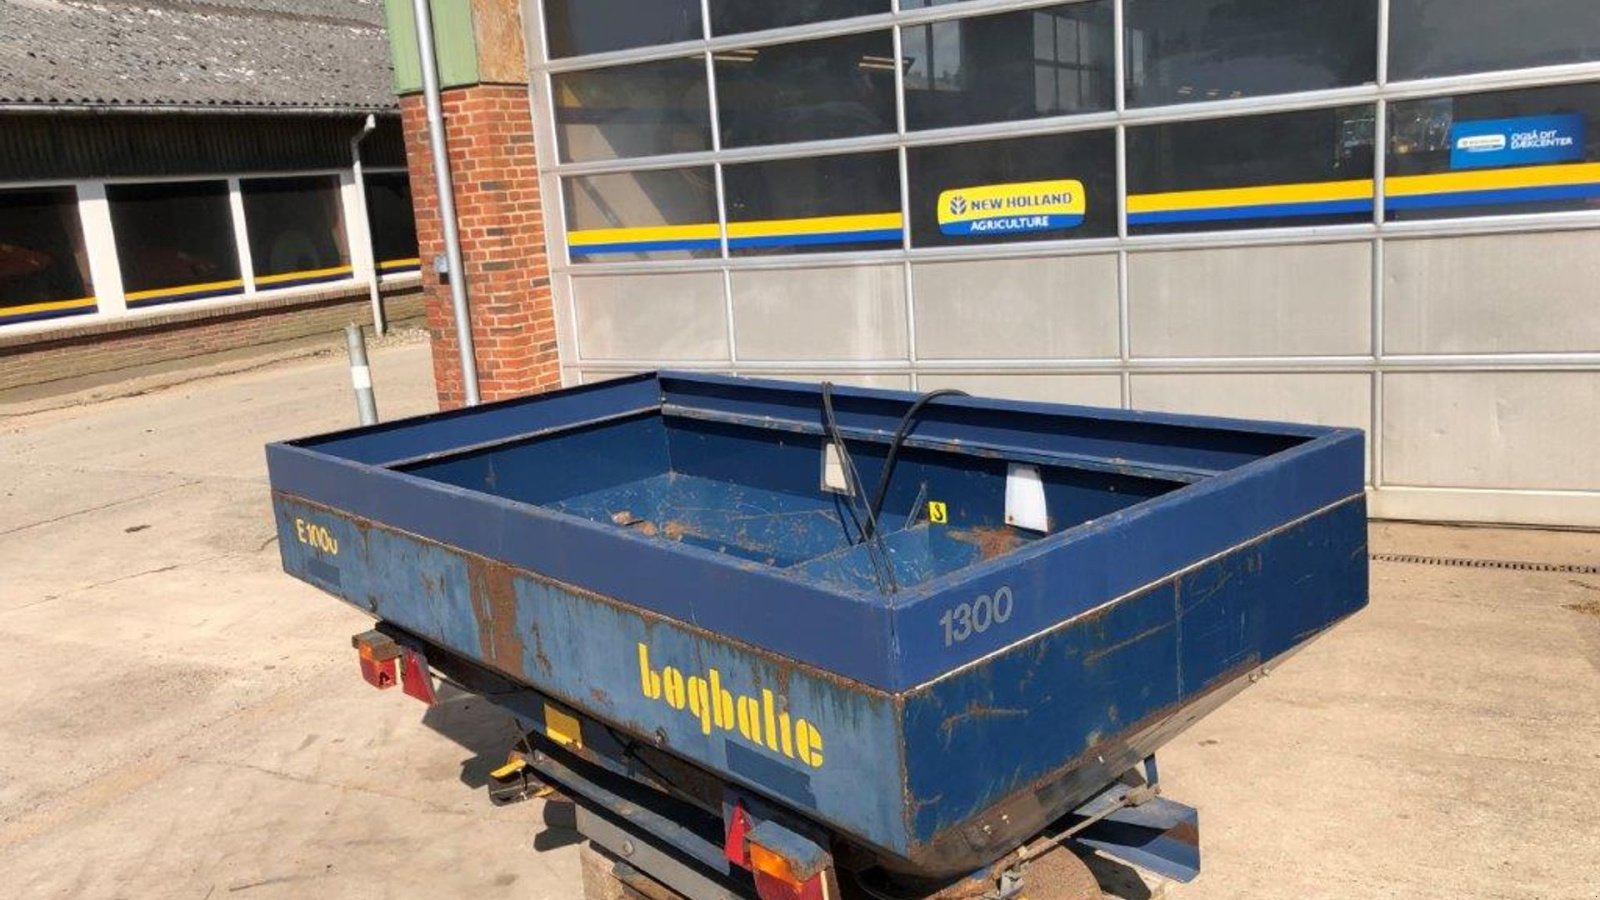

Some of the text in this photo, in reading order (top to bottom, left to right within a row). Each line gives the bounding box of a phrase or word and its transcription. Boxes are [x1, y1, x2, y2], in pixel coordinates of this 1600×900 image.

[971, 192, 1072, 211] NEW HOLLAND
[970, 215, 1049, 232] AGRICULTURE
[939, 586, 1013, 647] 1300
